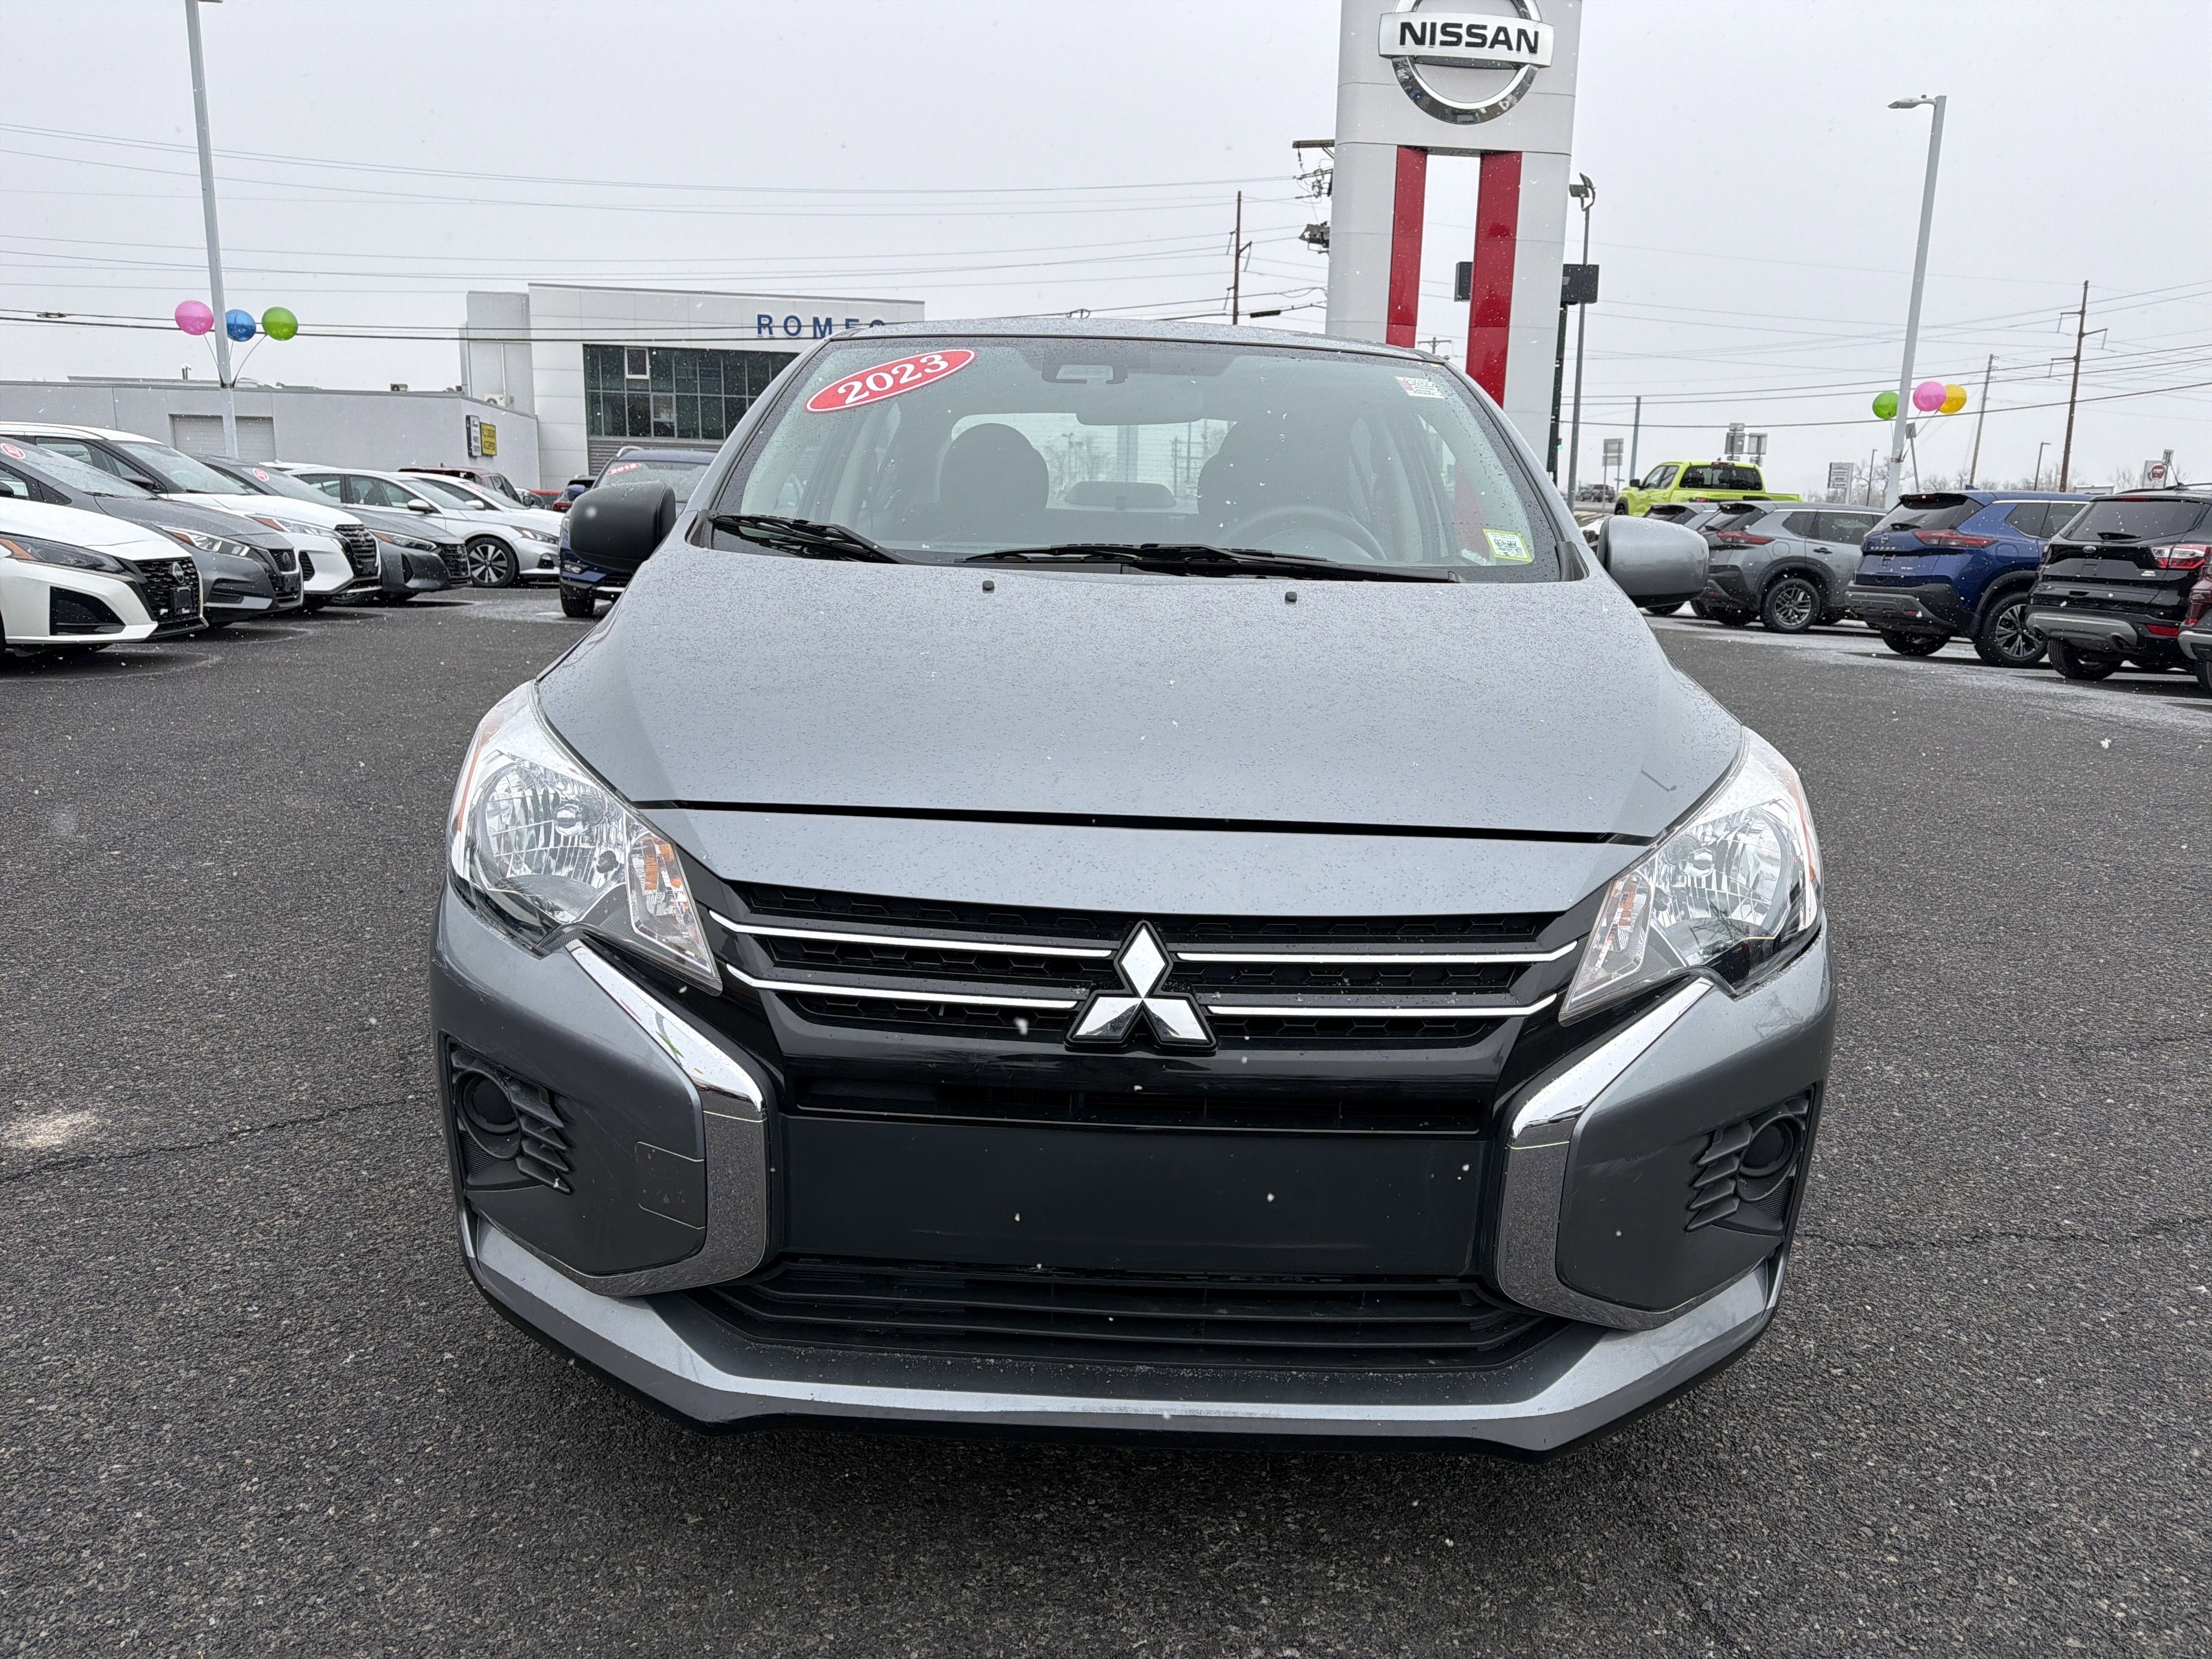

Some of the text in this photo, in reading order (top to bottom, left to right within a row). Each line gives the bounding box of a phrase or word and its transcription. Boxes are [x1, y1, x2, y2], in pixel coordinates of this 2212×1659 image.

[1400, 22, 1539, 54] NISSAN
[757, 314, 885, 338] ROME
[837, 354, 949, 404] 2023
